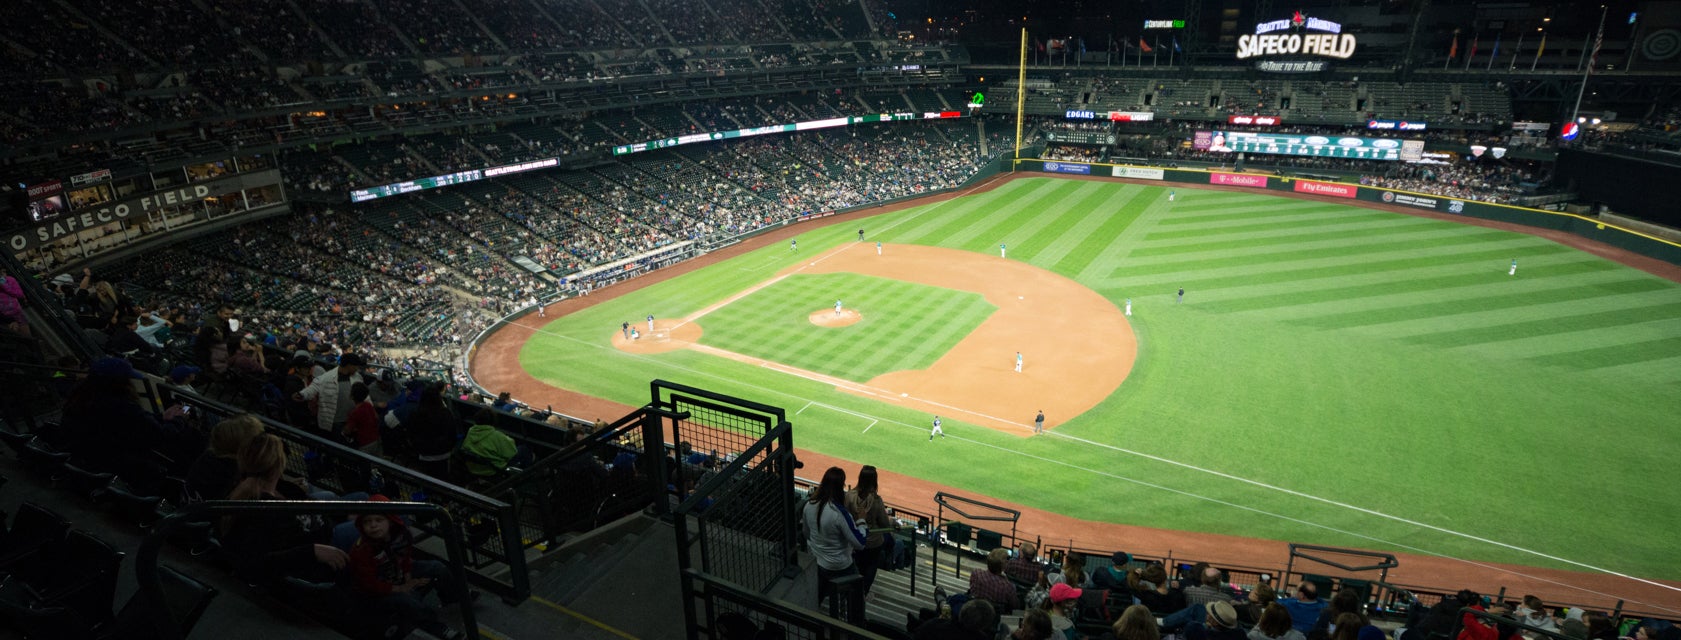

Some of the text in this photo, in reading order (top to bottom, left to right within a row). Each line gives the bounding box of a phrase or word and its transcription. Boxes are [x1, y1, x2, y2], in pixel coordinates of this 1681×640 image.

[1236, 33, 1356, 58] SAFECO FIELD
[1303, 182, 1348, 195] Fly Emirates
[36, 203, 130, 242] SAFECO
[140, 184, 209, 211] FIELD
